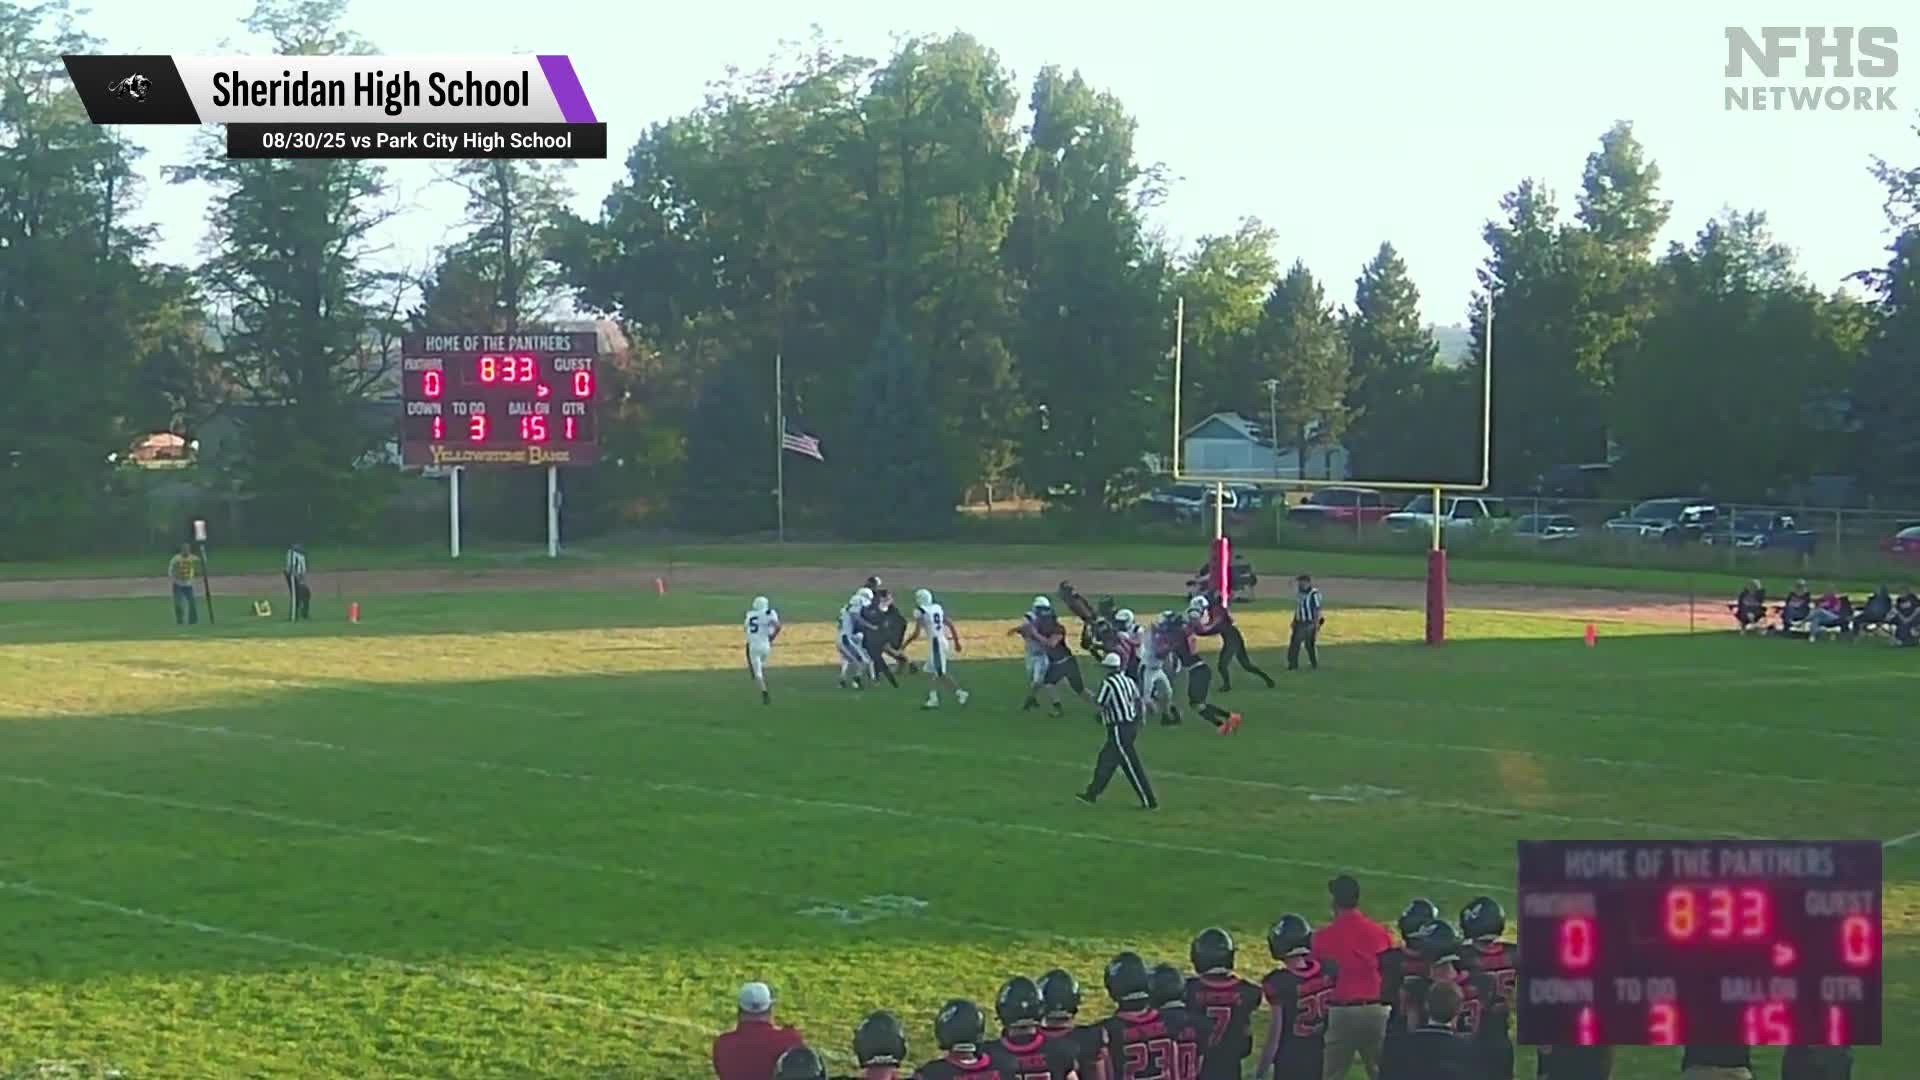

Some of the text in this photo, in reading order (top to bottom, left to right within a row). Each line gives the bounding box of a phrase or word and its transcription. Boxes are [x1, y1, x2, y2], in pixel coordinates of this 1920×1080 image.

[426, 335, 571, 351] HOME OF THE PANTHERS
[554, 357, 592, 371] GUEST
[425, 371, 439, 396] 0
[575, 371, 590, 396] 0
[407, 402, 441, 415] DOWN
[452, 402, 467, 415] TO
[508, 402, 533, 415] BALL
[434, 416, 441, 439] 1
[471, 415, 485, 440] 3
[522, 416, 545, 440] 15
[566, 417, 573, 439] 1
[749, 616, 759, 634] 5
[1206, 1007, 1231, 1046] 7
[1123, 1038, 1172, 1080] 23
